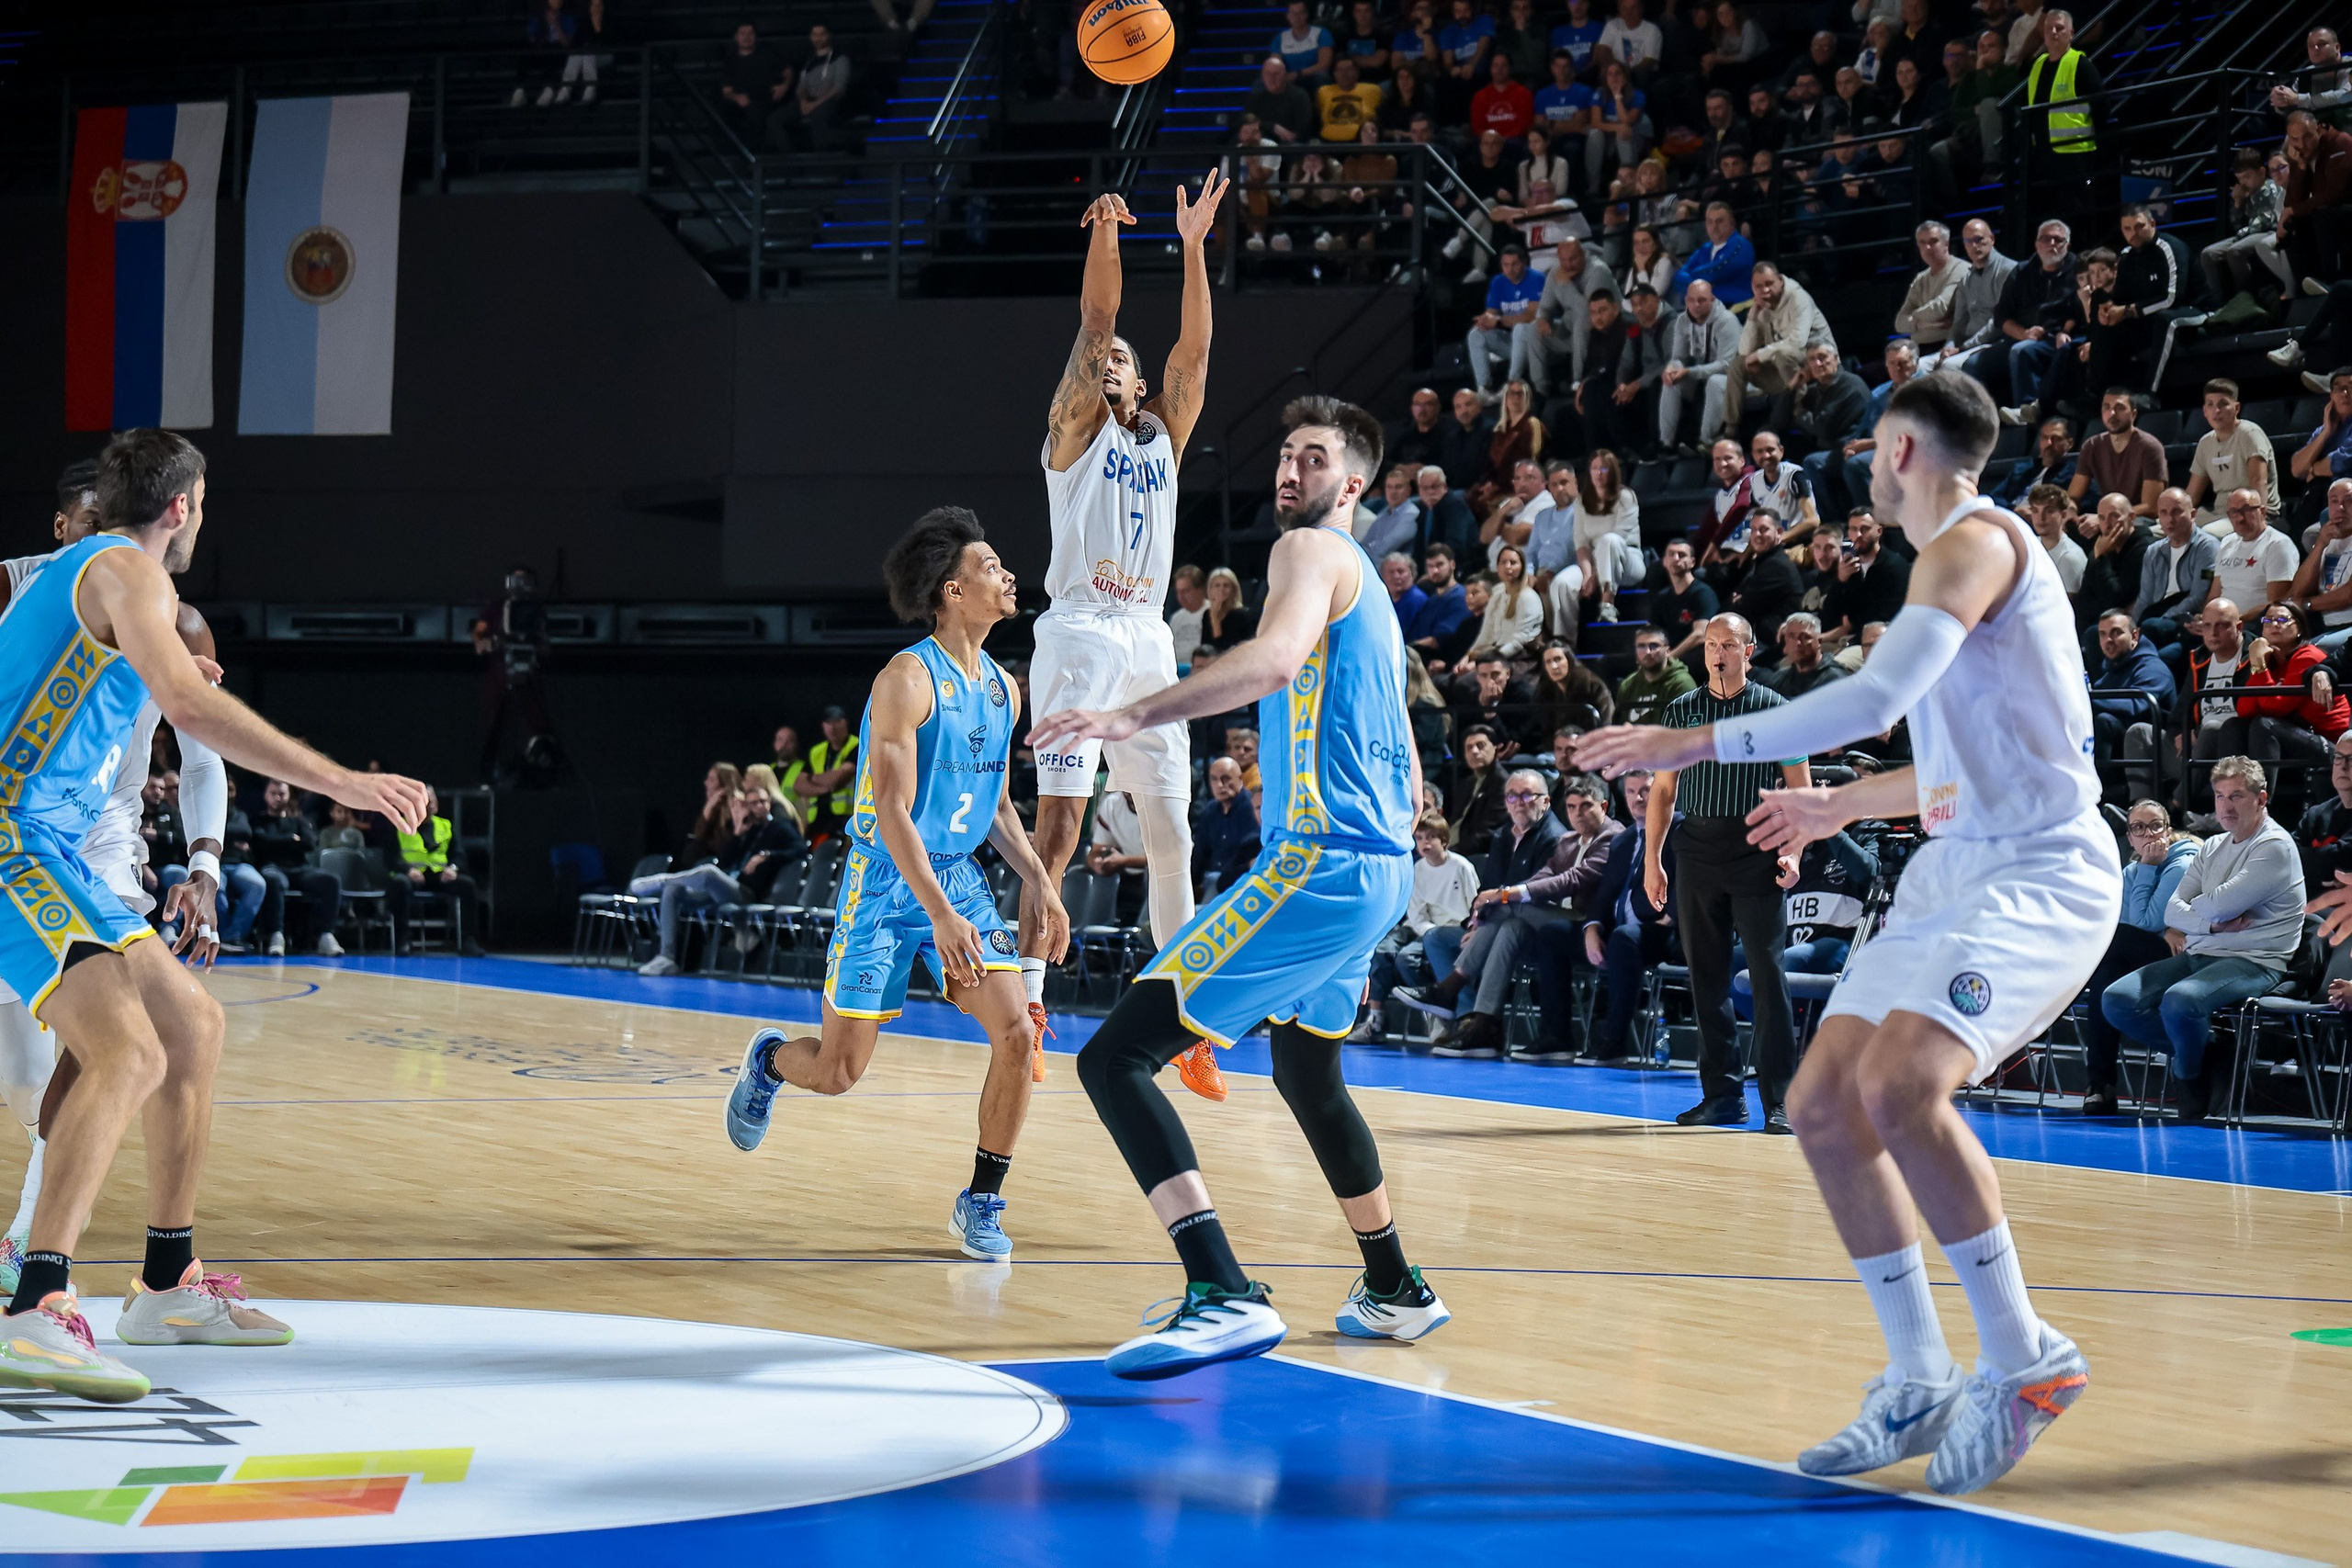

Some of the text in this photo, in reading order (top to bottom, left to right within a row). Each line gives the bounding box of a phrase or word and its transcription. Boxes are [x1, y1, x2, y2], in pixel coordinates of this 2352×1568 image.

[1125, 30, 1147, 47] FIBA
[1130, 511, 1144, 550] 7
[933, 759, 1007, 774] DREAMLAND
[1039, 753, 1084, 768] OFFICE
[949, 793, 973, 834] 2
